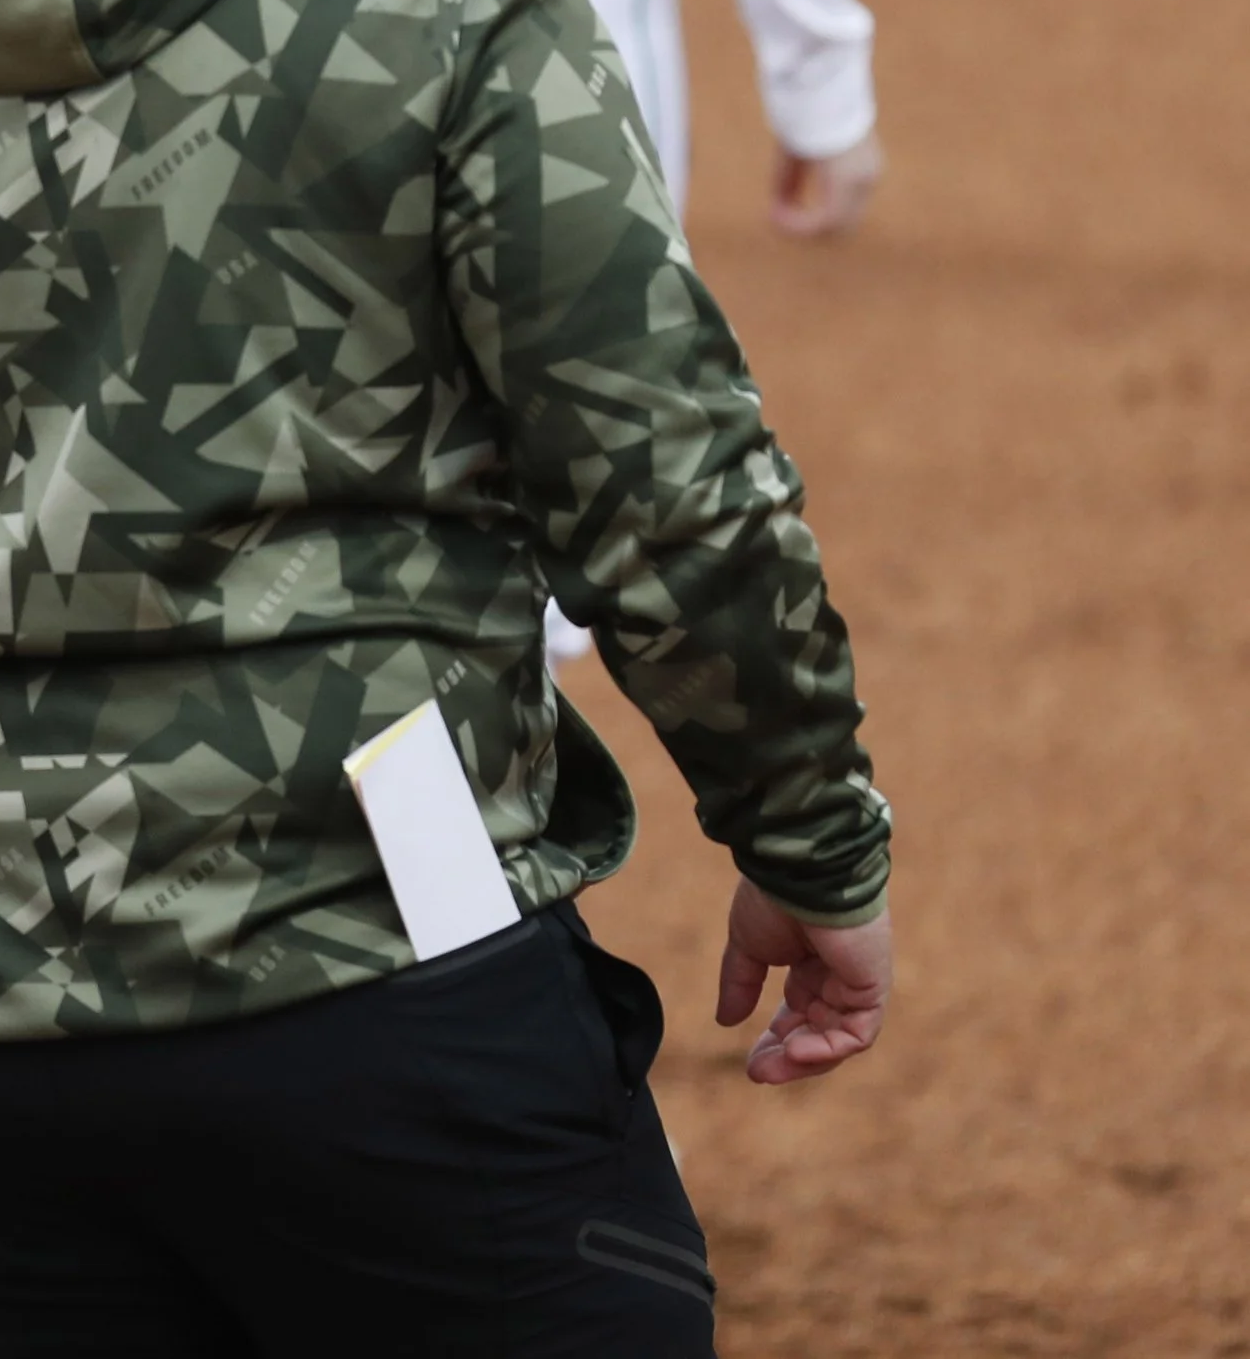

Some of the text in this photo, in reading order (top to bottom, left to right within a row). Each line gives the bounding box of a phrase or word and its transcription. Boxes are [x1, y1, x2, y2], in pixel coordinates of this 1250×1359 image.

[130, 127, 212, 202] FREEDOM
[216, 250, 259, 285] USA
[144, 846, 230, 917] FREEDOM
